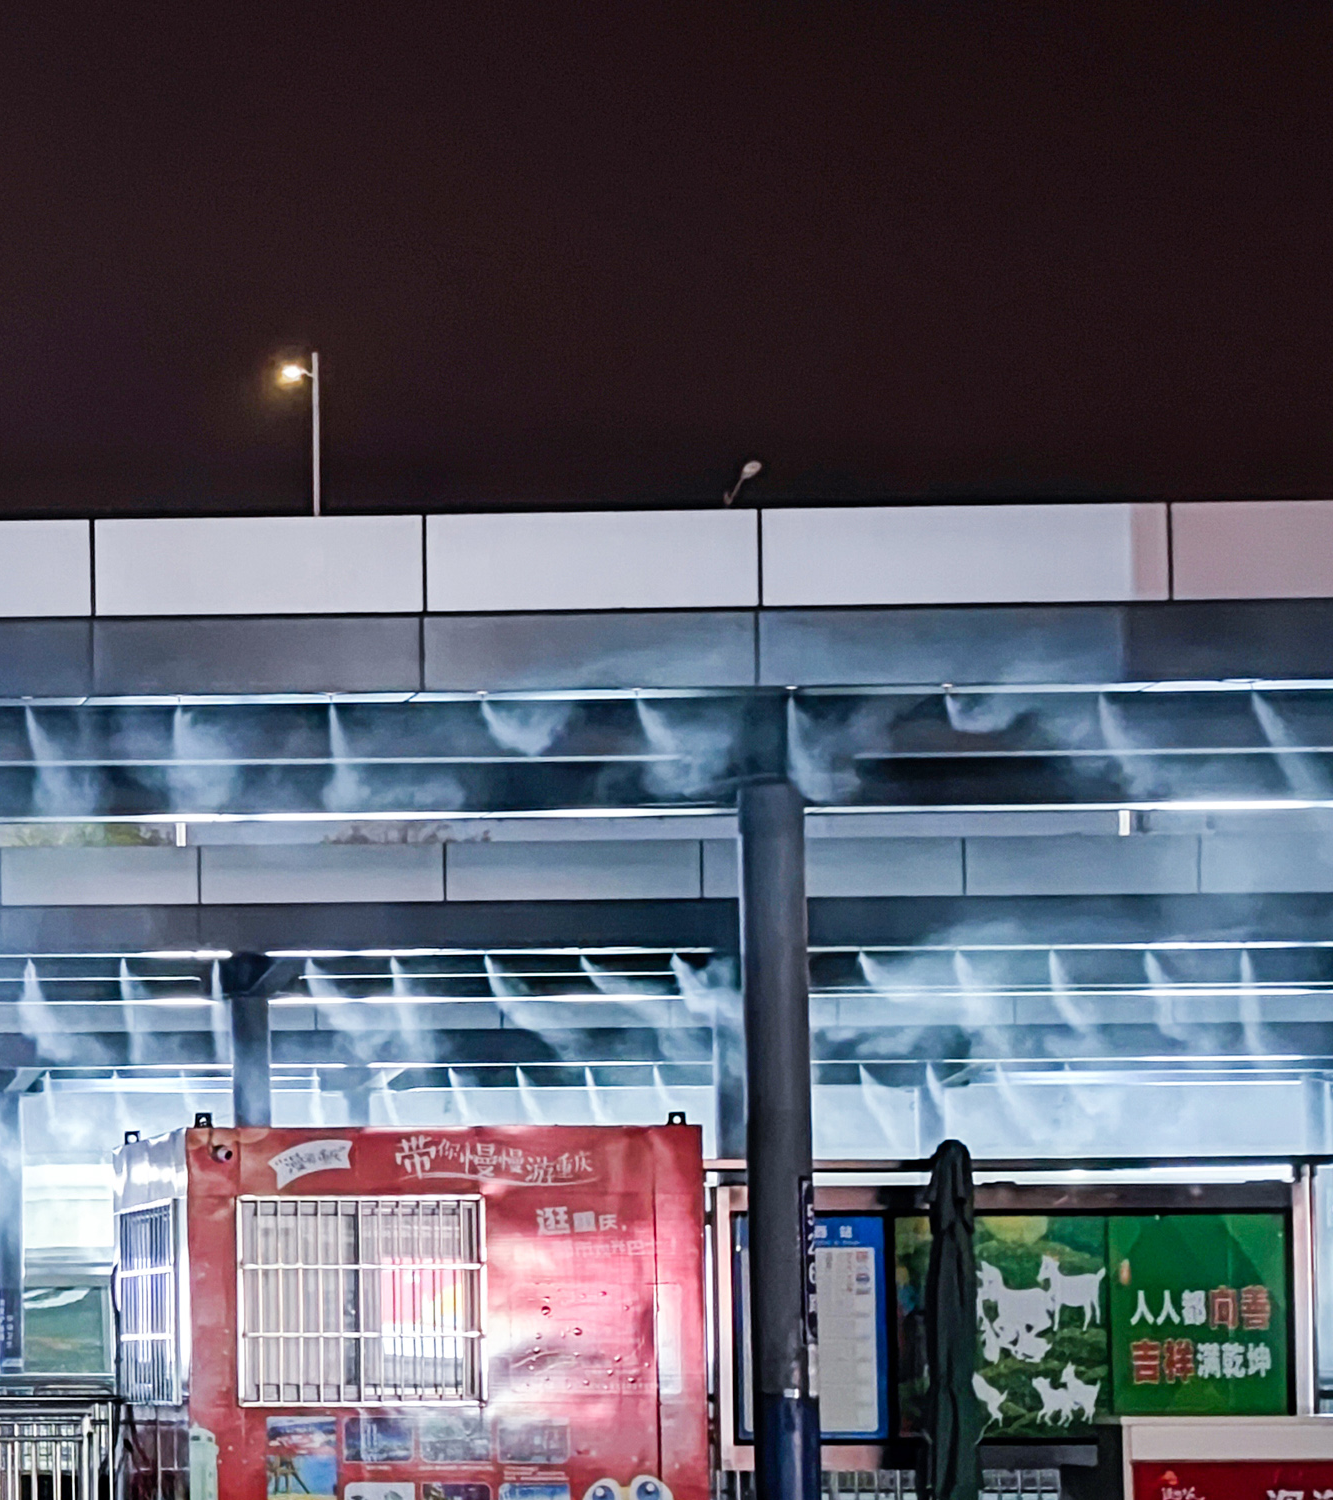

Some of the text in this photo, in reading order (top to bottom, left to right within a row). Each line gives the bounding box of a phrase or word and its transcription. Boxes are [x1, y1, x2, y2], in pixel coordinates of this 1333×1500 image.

[395, 1135, 593, 1183] 带你慢慢游重庆
[1130, 1285, 1271, 1330] 人人都向善
[1130, 1338, 1272, 1384] 吉祥满乾坤
